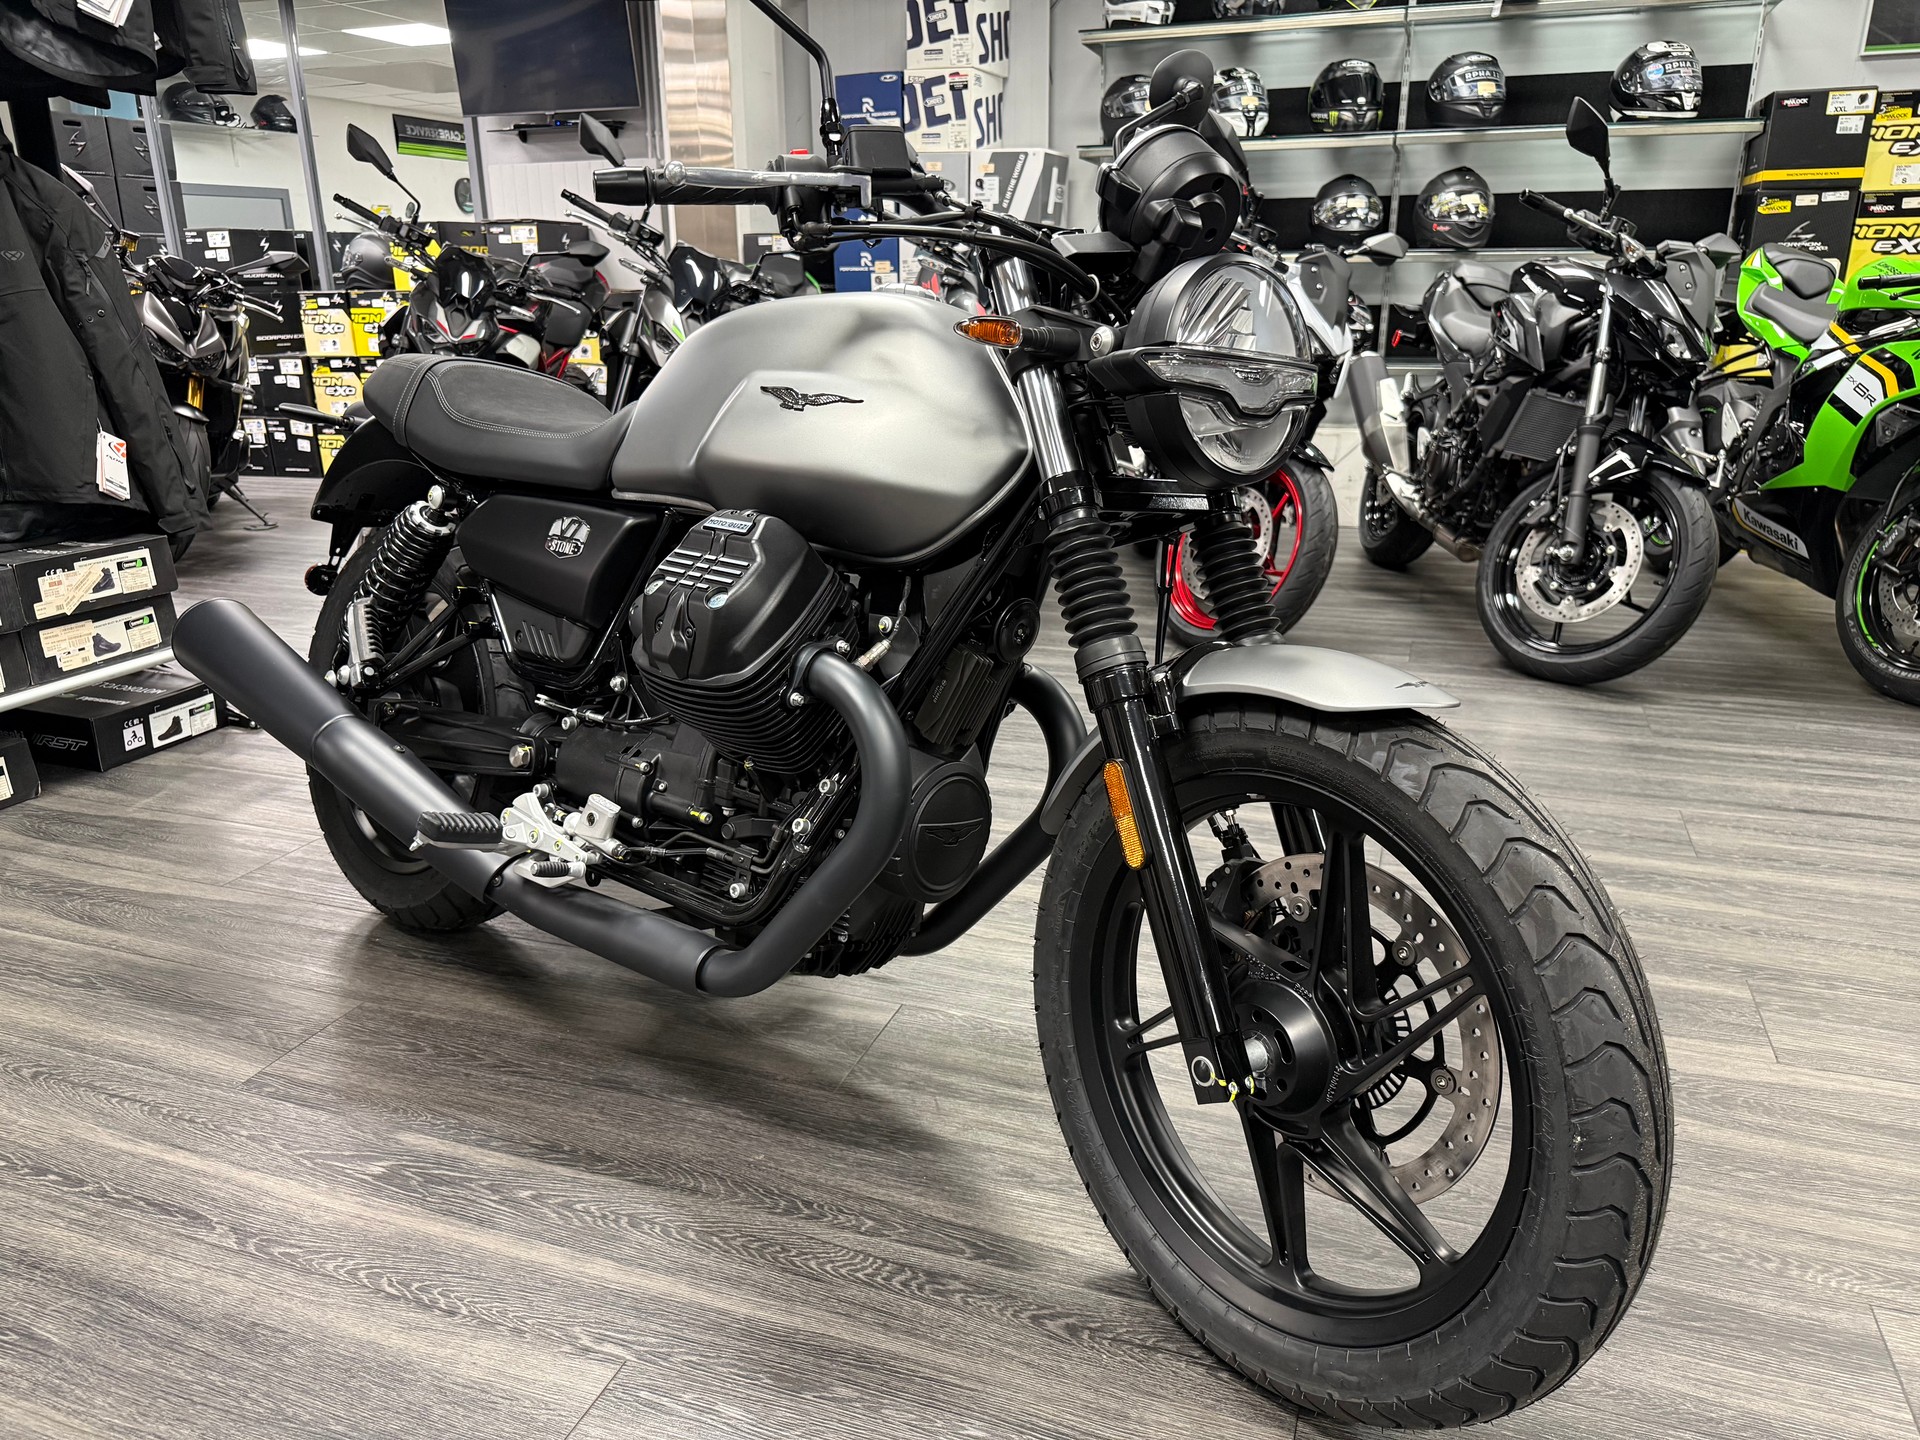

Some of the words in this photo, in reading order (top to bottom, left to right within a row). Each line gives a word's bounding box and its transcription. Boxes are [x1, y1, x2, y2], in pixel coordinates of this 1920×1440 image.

[1465, 70, 1491, 79] RPHA
[1012, 154, 1026, 183] WORLD
[314, 323, 345, 334] EXO
[325, 385, 356, 397] EXO
[1853, 383, 1877, 408] 6R
[707, 518, 728, 527] MOTO
[728, 521, 750, 530] GUZZI
[1743, 508, 1799, 550] Kawasaki
[549, 540, 578, 555] STONE
